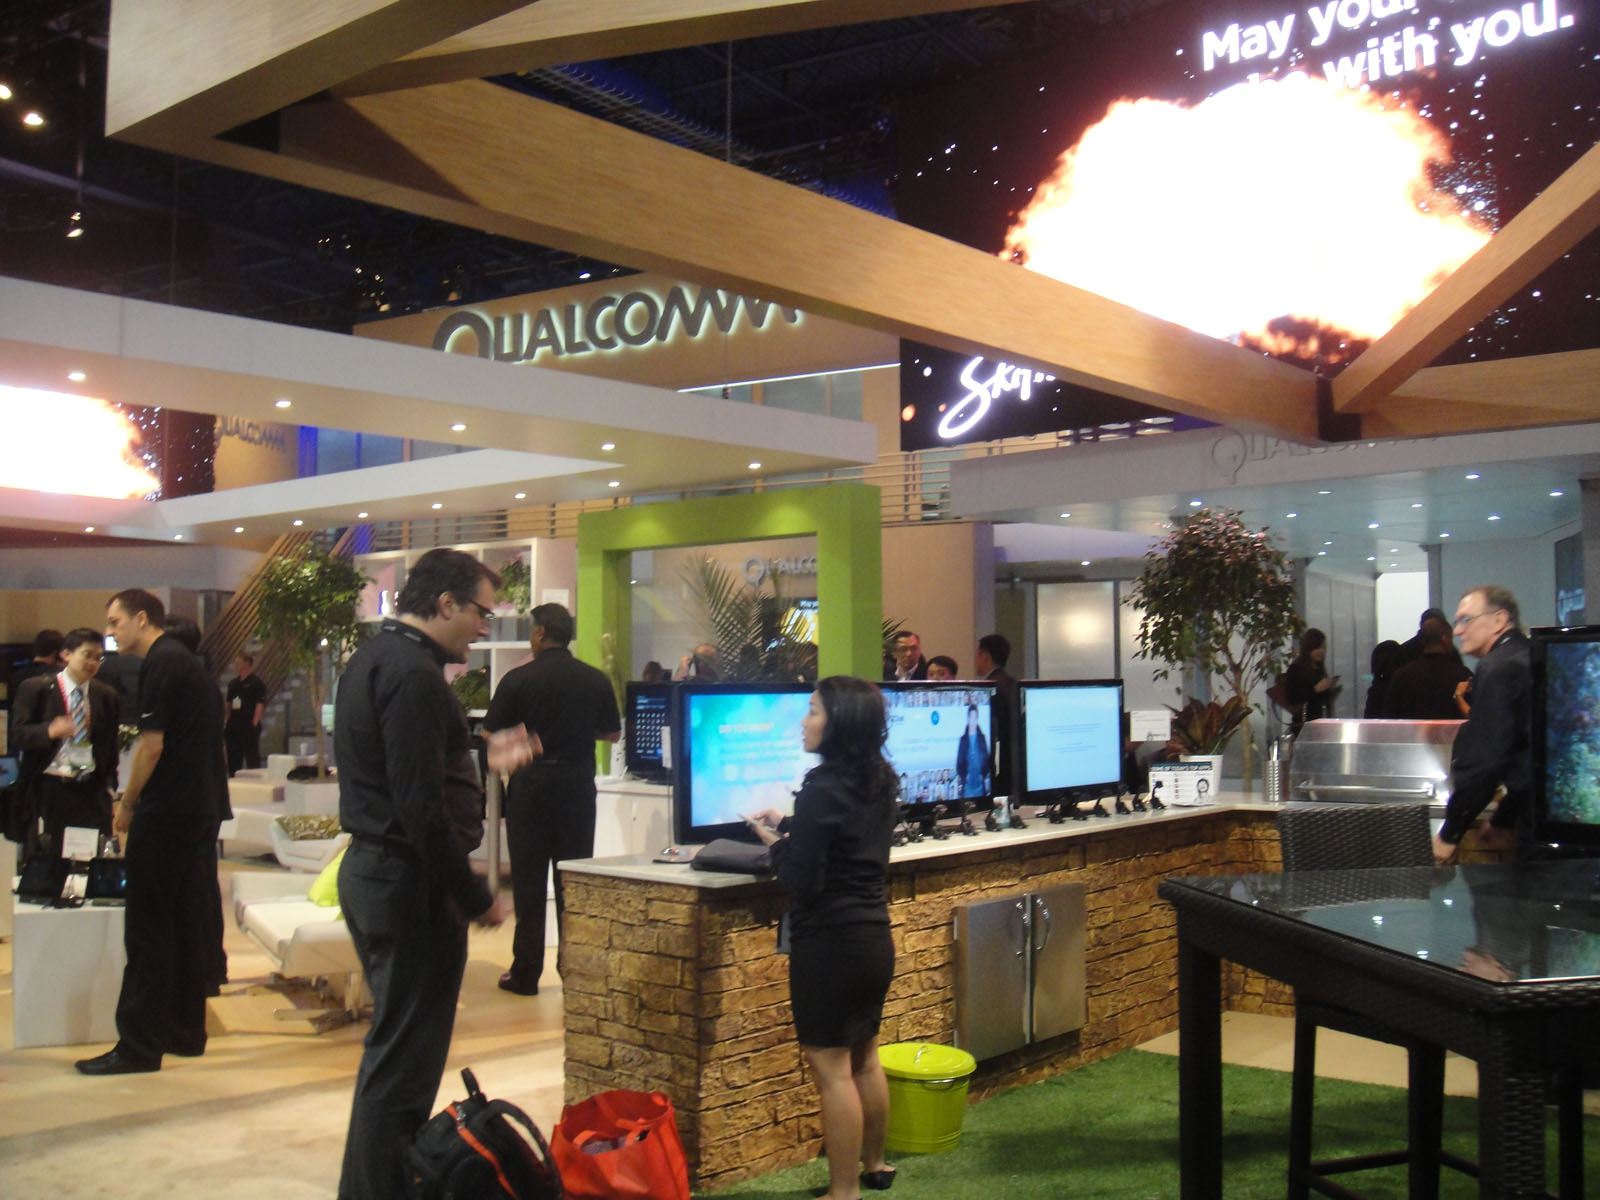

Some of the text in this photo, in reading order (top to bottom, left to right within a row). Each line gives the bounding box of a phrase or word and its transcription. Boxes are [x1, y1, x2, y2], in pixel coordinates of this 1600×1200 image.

[1202, 13, 1296, 72] May
[1322, 0, 1575, 89] with you.
[743, 555, 818, 590] QUALCO
